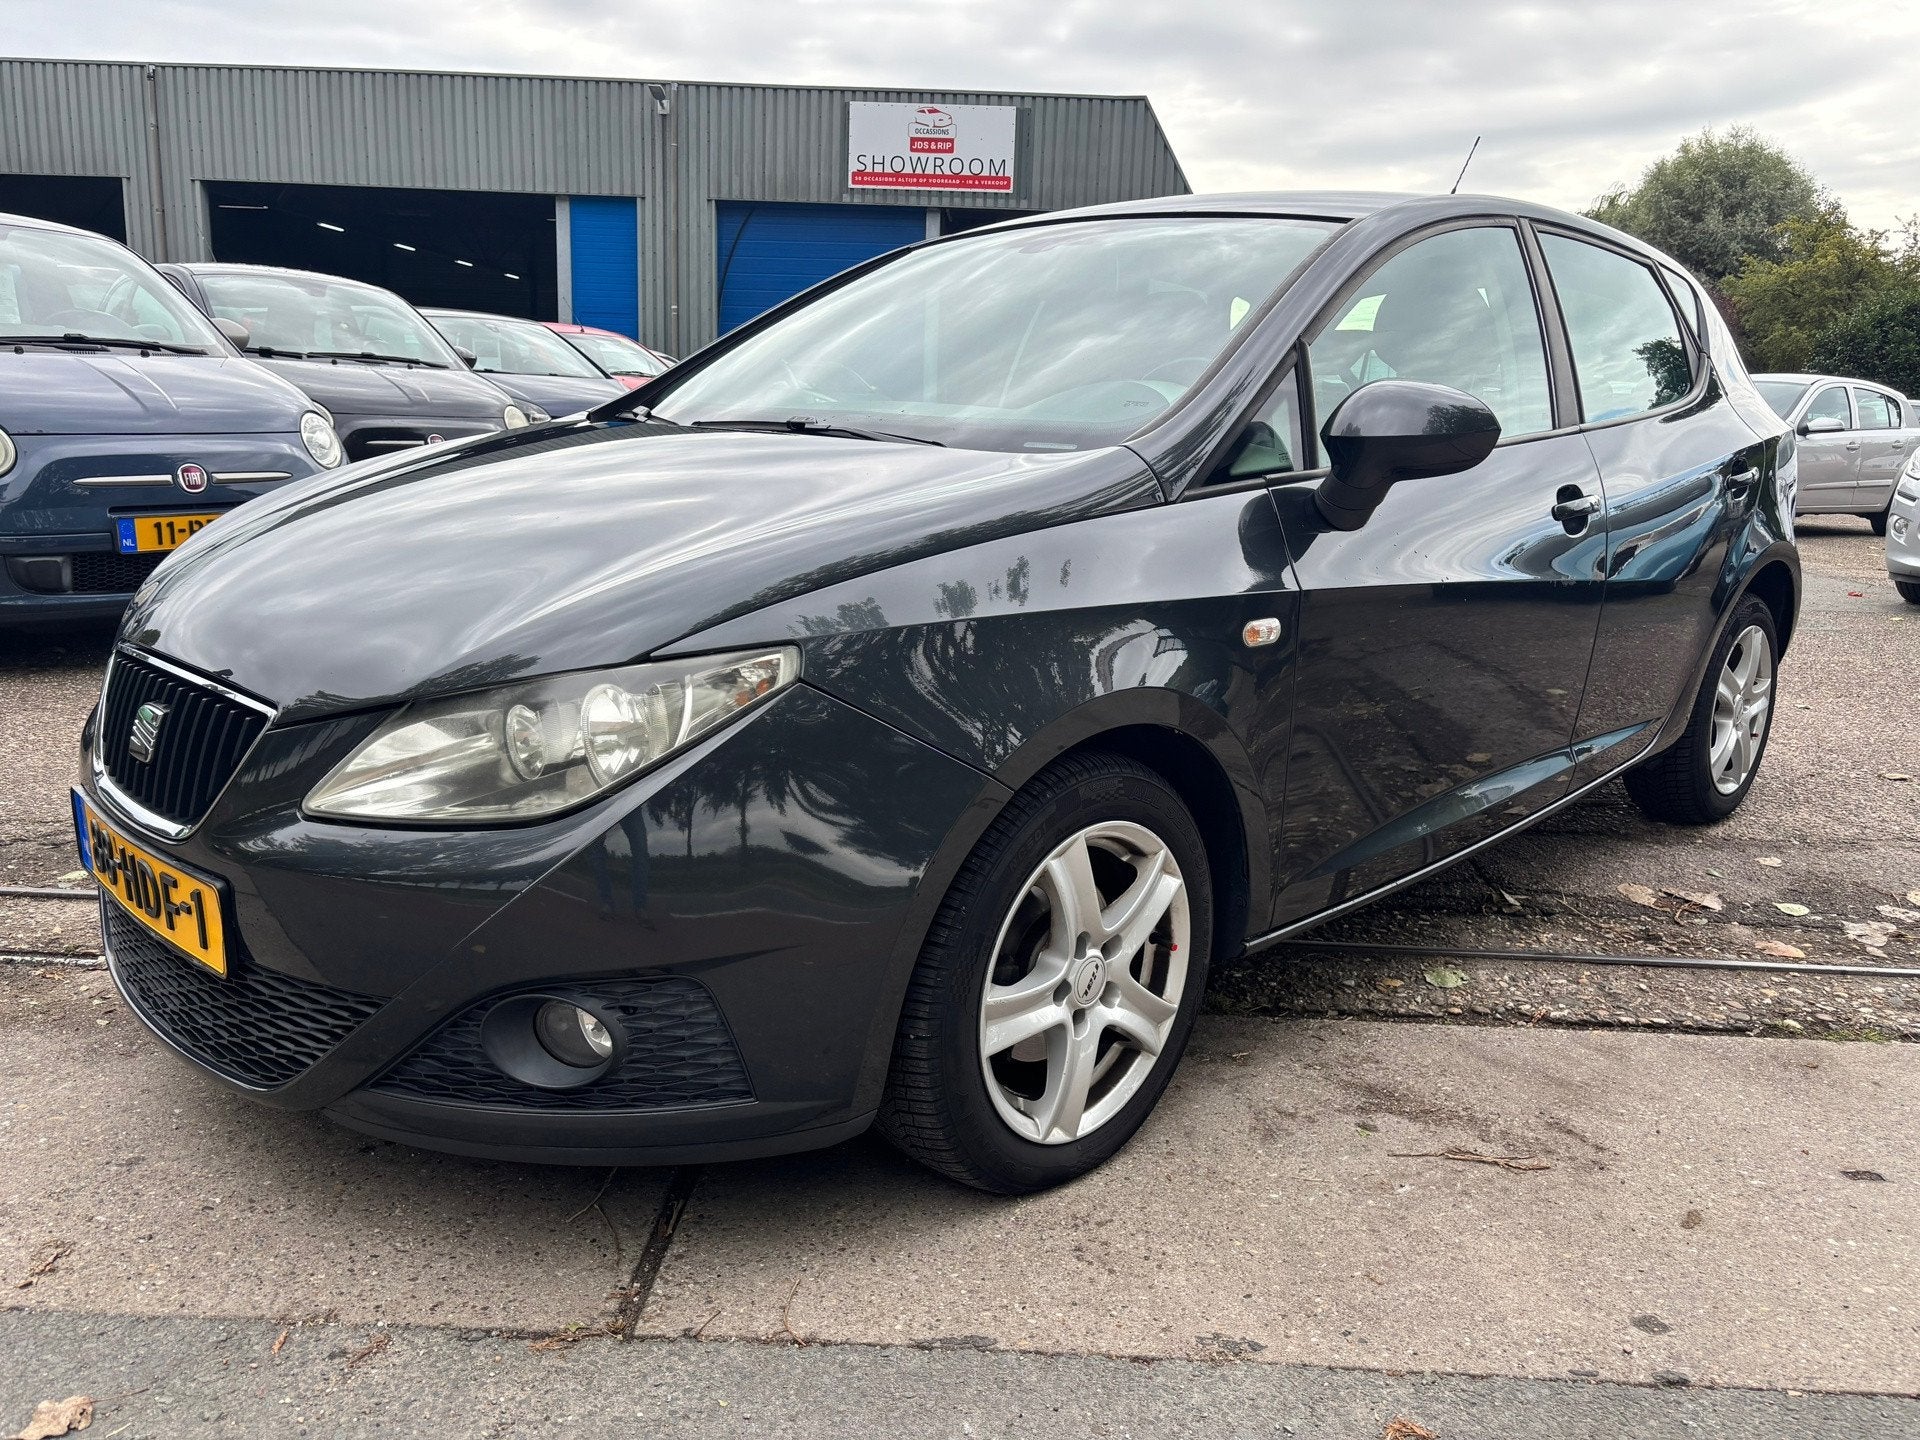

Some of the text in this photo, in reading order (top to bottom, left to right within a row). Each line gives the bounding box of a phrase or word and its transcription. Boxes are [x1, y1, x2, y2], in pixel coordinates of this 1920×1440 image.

[914, 127, 950, 136] OCCASSIONS
[911, 141, 952, 150] JDS & RIP
[856, 154, 1006, 176] SHOWROOM
[183, 472, 202, 486] FIAT
